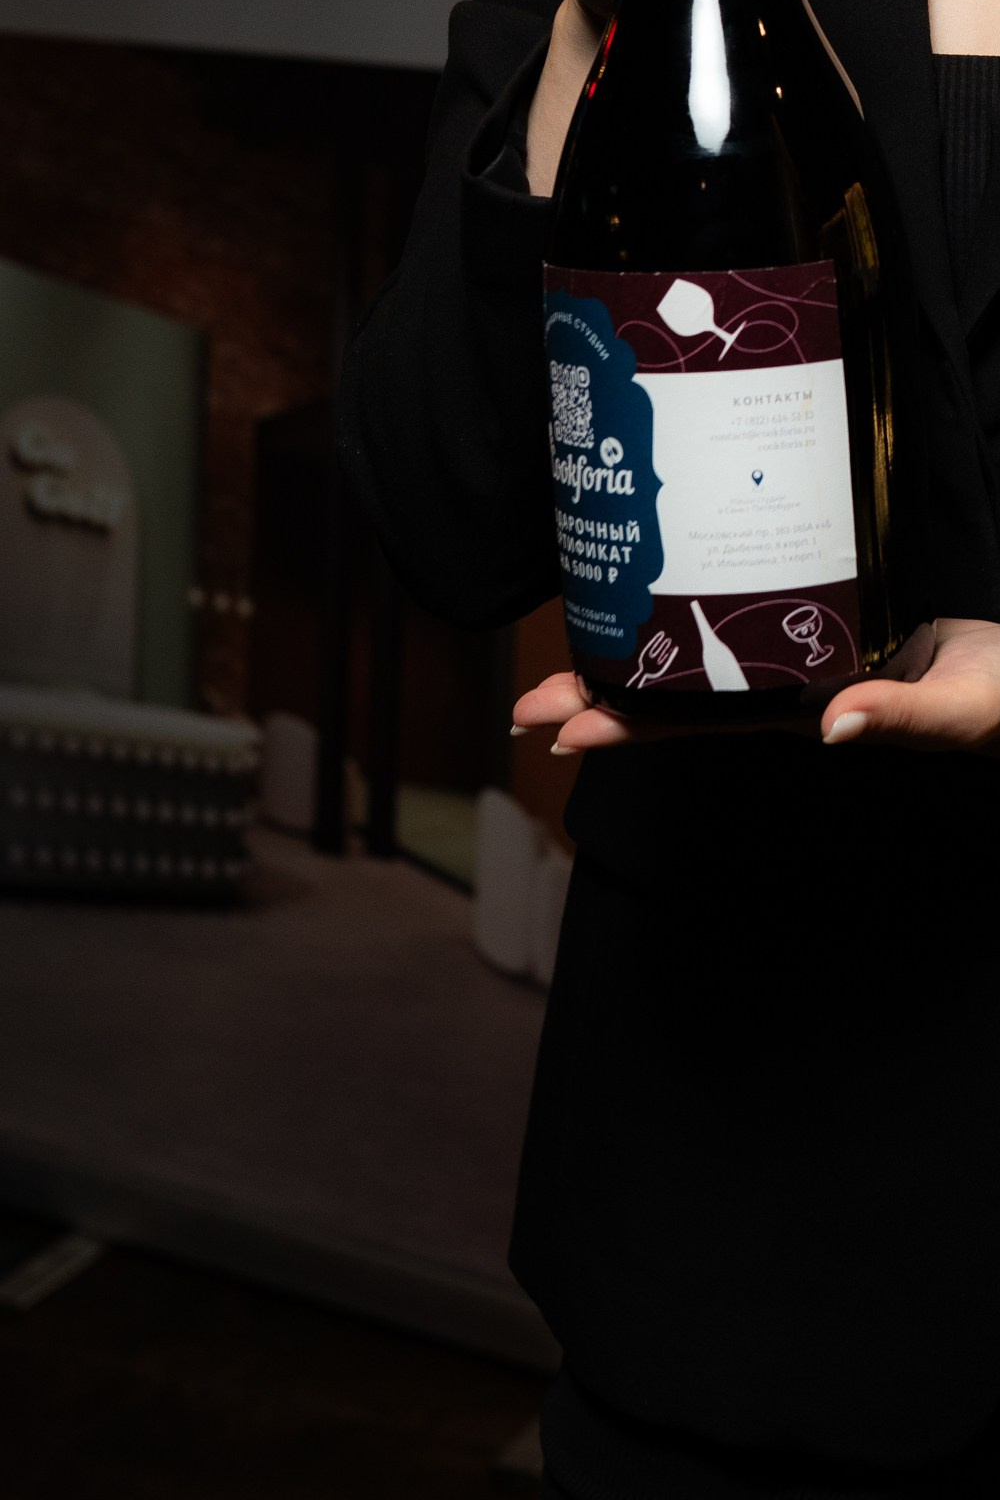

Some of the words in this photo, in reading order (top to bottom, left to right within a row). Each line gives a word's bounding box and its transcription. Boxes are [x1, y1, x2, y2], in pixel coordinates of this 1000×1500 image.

[733, 390, 813, 407] КОНТАКТЫ
[555, 507, 641, 543] ДАРОЧНЫЙ
[572, 559, 602, 582] 5000
